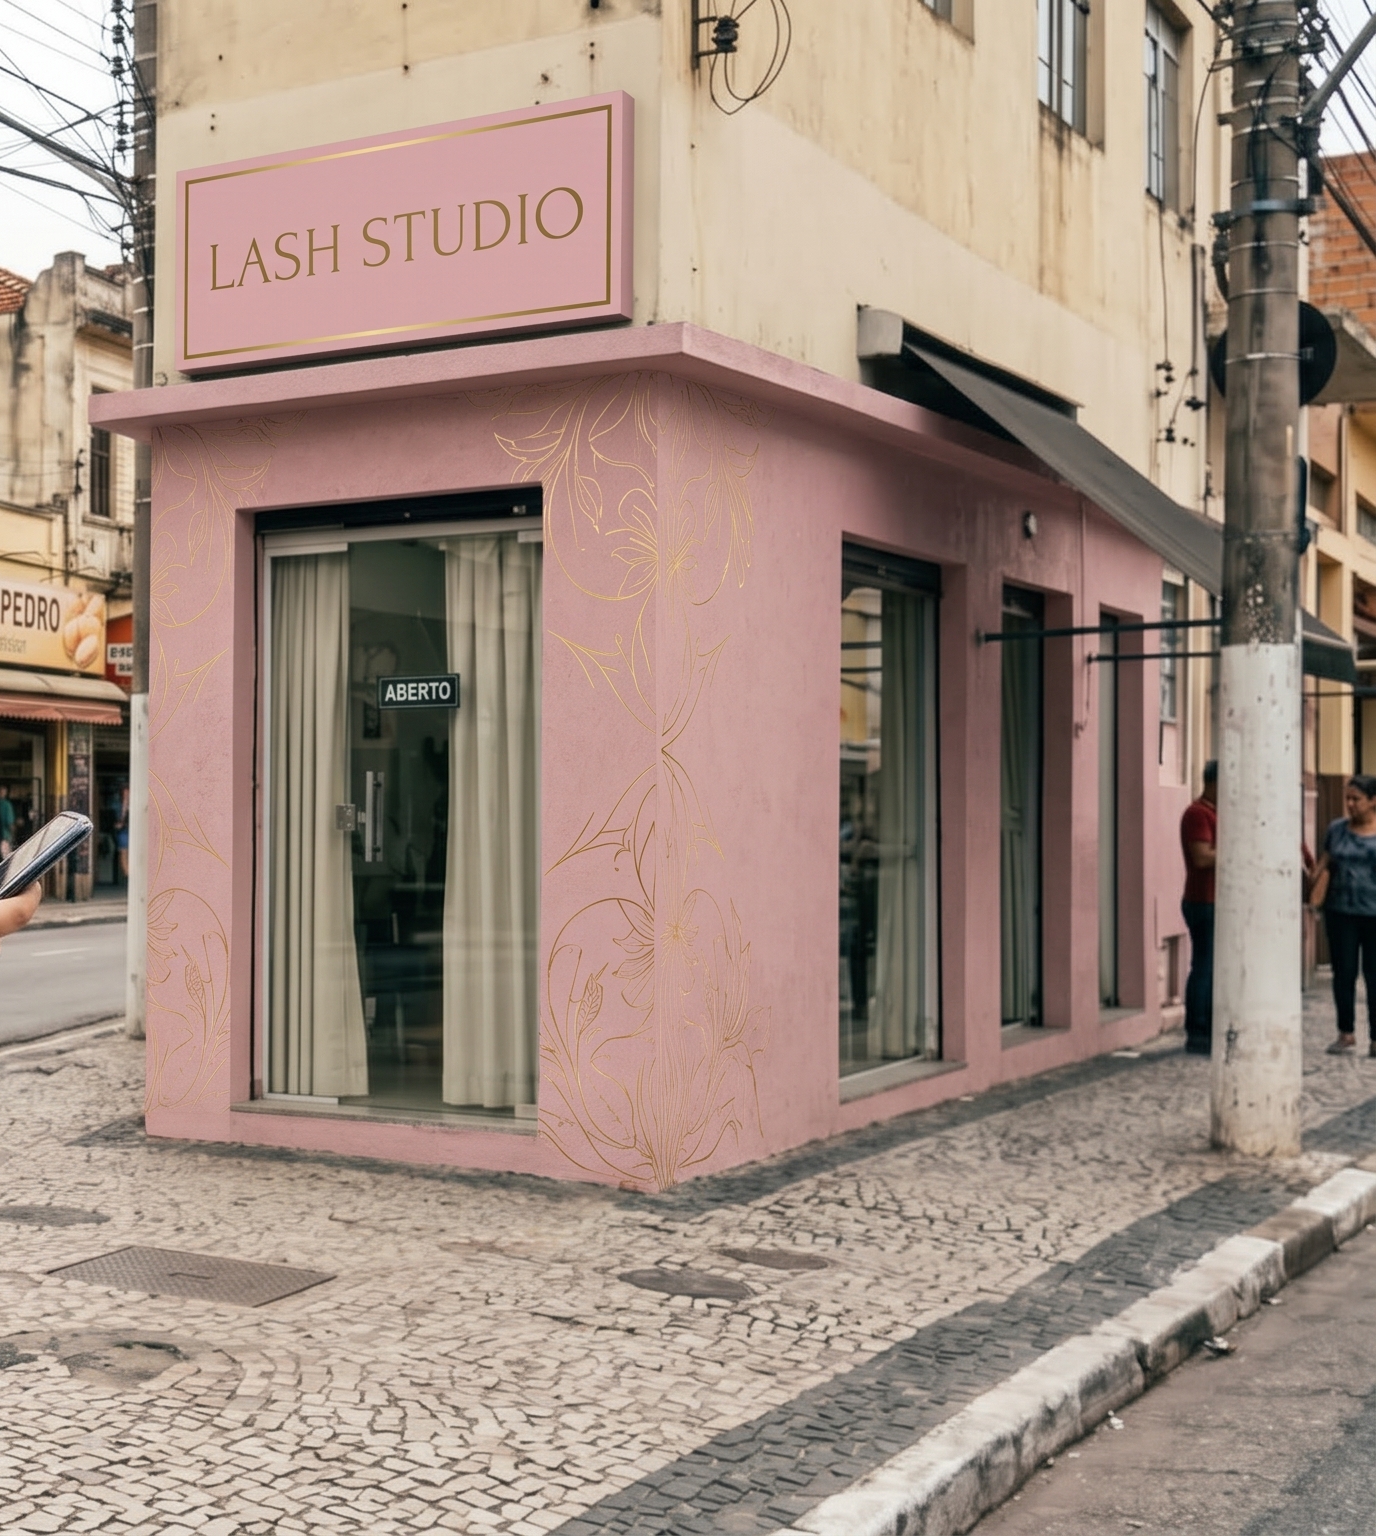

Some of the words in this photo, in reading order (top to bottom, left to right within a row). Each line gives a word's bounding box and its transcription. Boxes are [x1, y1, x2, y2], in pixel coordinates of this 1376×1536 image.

[209, 223, 341, 292] LASH
[362, 186, 584, 268] STUDIO
[0, 588, 61, 634] PEDRO
[384, 681, 451, 702] ABERTO
